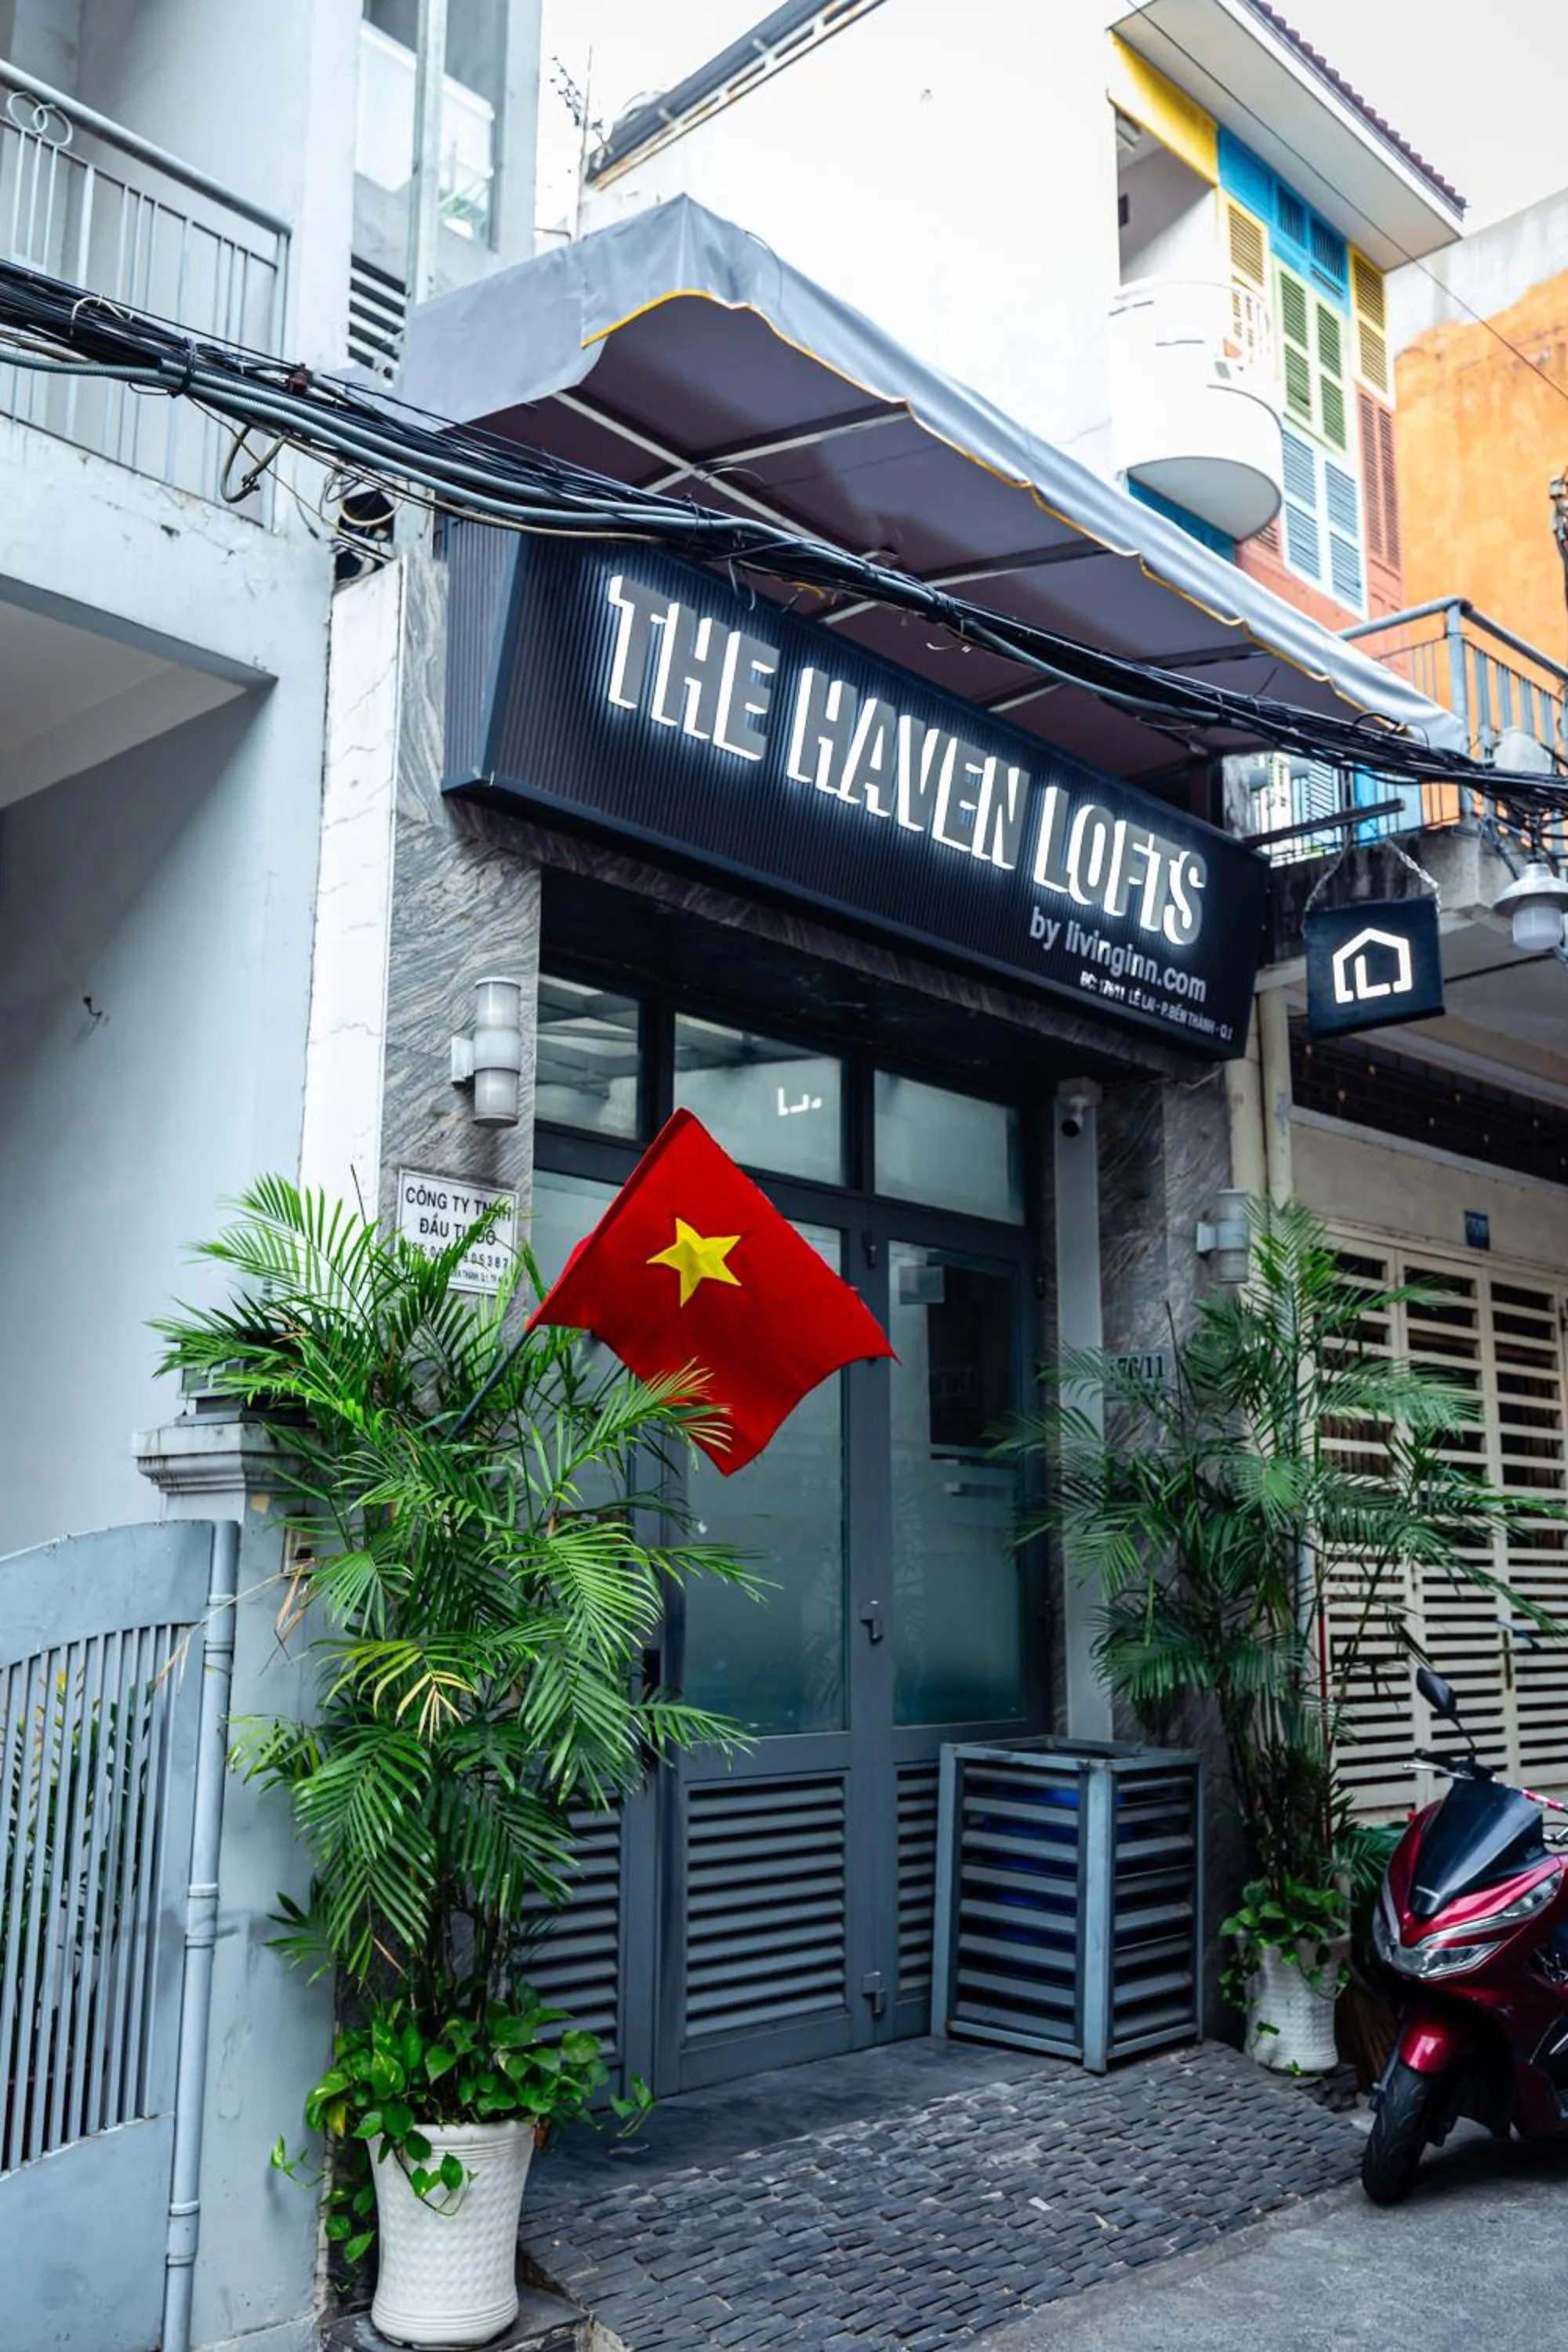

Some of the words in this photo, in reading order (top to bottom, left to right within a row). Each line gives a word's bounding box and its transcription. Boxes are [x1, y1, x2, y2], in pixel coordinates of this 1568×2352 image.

[608, 573, 781, 761] THE
[786, 666, 1030, 870] HAVEN
[1033, 786, 1207, 946] LOFTS
[1030, 906, 1061, 951] by
[1065, 920, 1207, 1003] livinginn.com
[405, 1185, 447, 1210] CÔNG
[452, 1196, 470, 1214] TY
